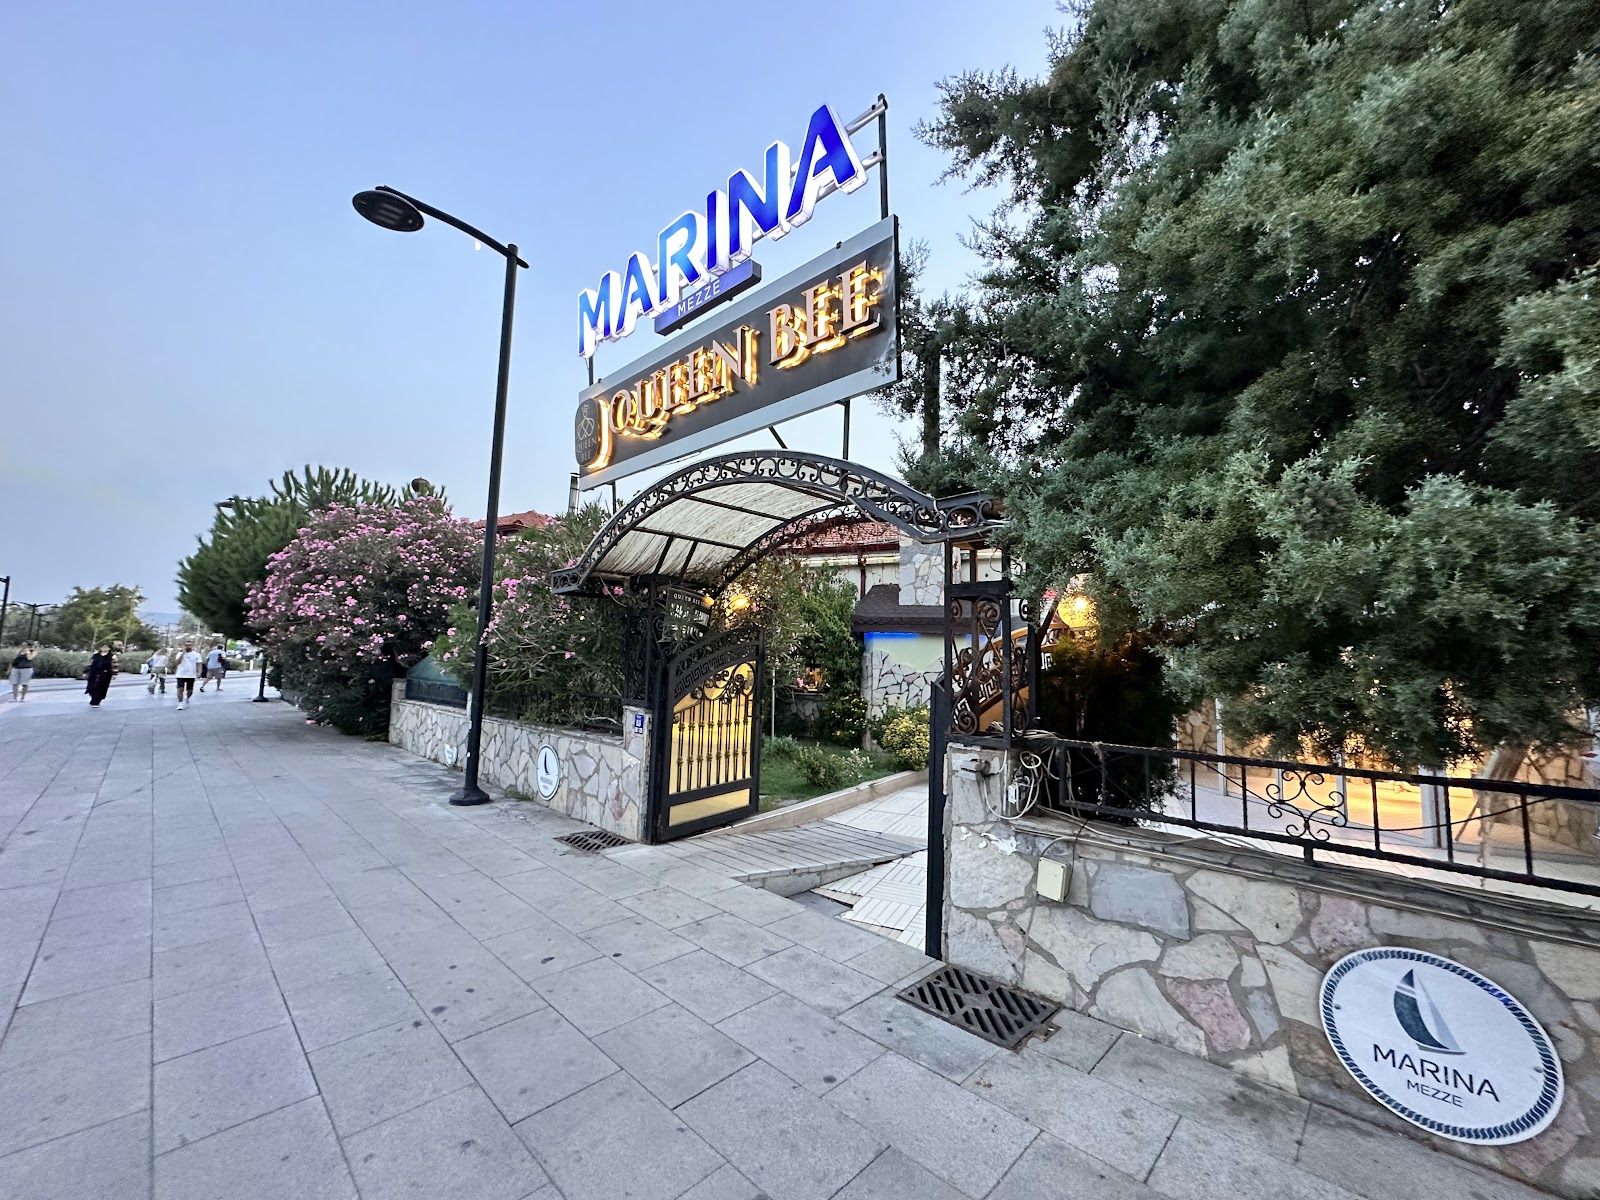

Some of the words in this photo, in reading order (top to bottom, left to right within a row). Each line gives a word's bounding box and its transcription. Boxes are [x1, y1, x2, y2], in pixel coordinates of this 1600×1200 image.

[577, 102, 866, 357] MARINA
[677, 278, 721, 317] MEZZE
[608, 325, 757, 436] QUEEN
[766, 260, 883, 367] BEE
[577, 436, 597, 453] QUEEN
[581, 450, 591, 462] BEE
[1373, 1043, 1500, 1103] MARINA
[1406, 1079, 1463, 1108] MEZZE
